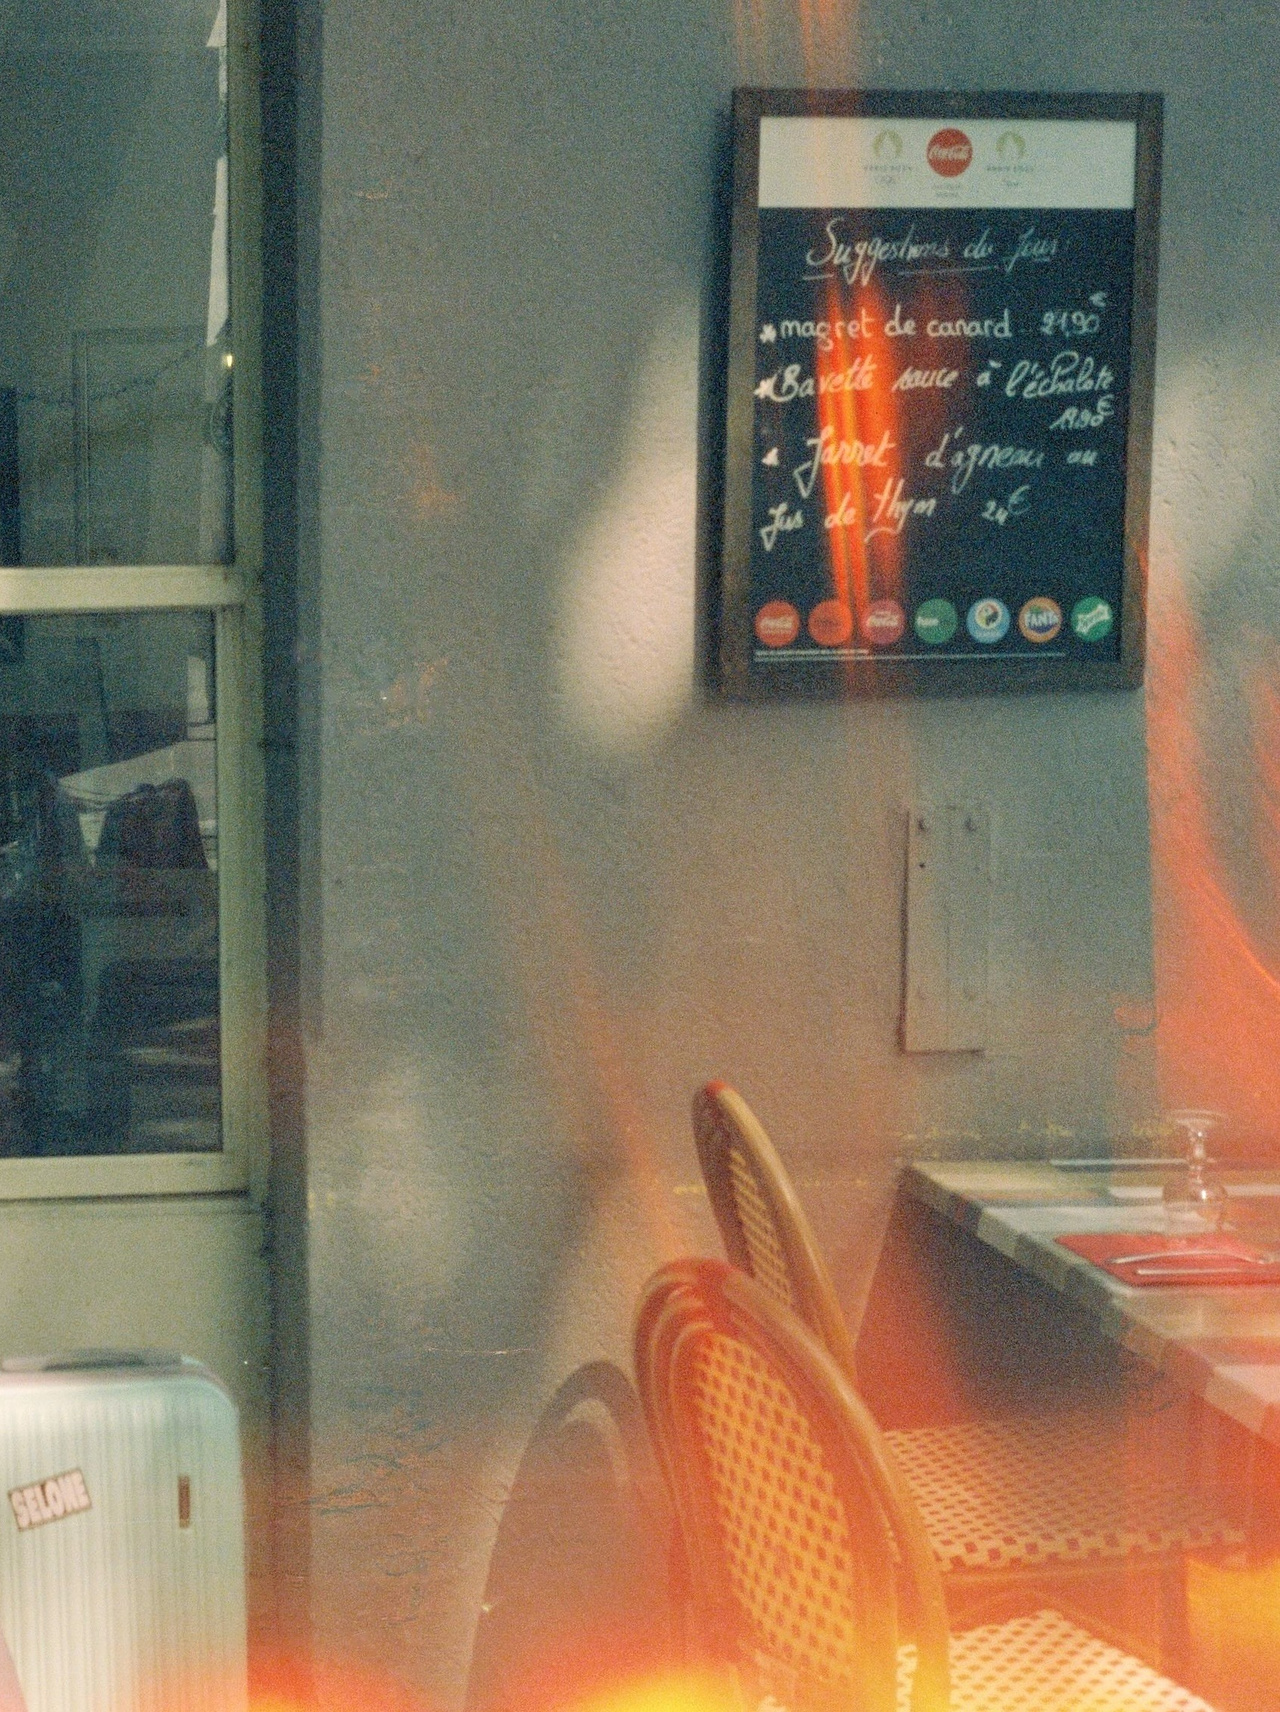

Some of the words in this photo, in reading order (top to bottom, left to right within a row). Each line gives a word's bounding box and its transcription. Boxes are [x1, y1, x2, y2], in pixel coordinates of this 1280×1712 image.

[963, 227, 994, 260] du
[780, 307, 876, 352] magret
[884, 303, 916, 338] de
[926, 308, 1013, 339] canard
[824, 491, 857, 530] de
